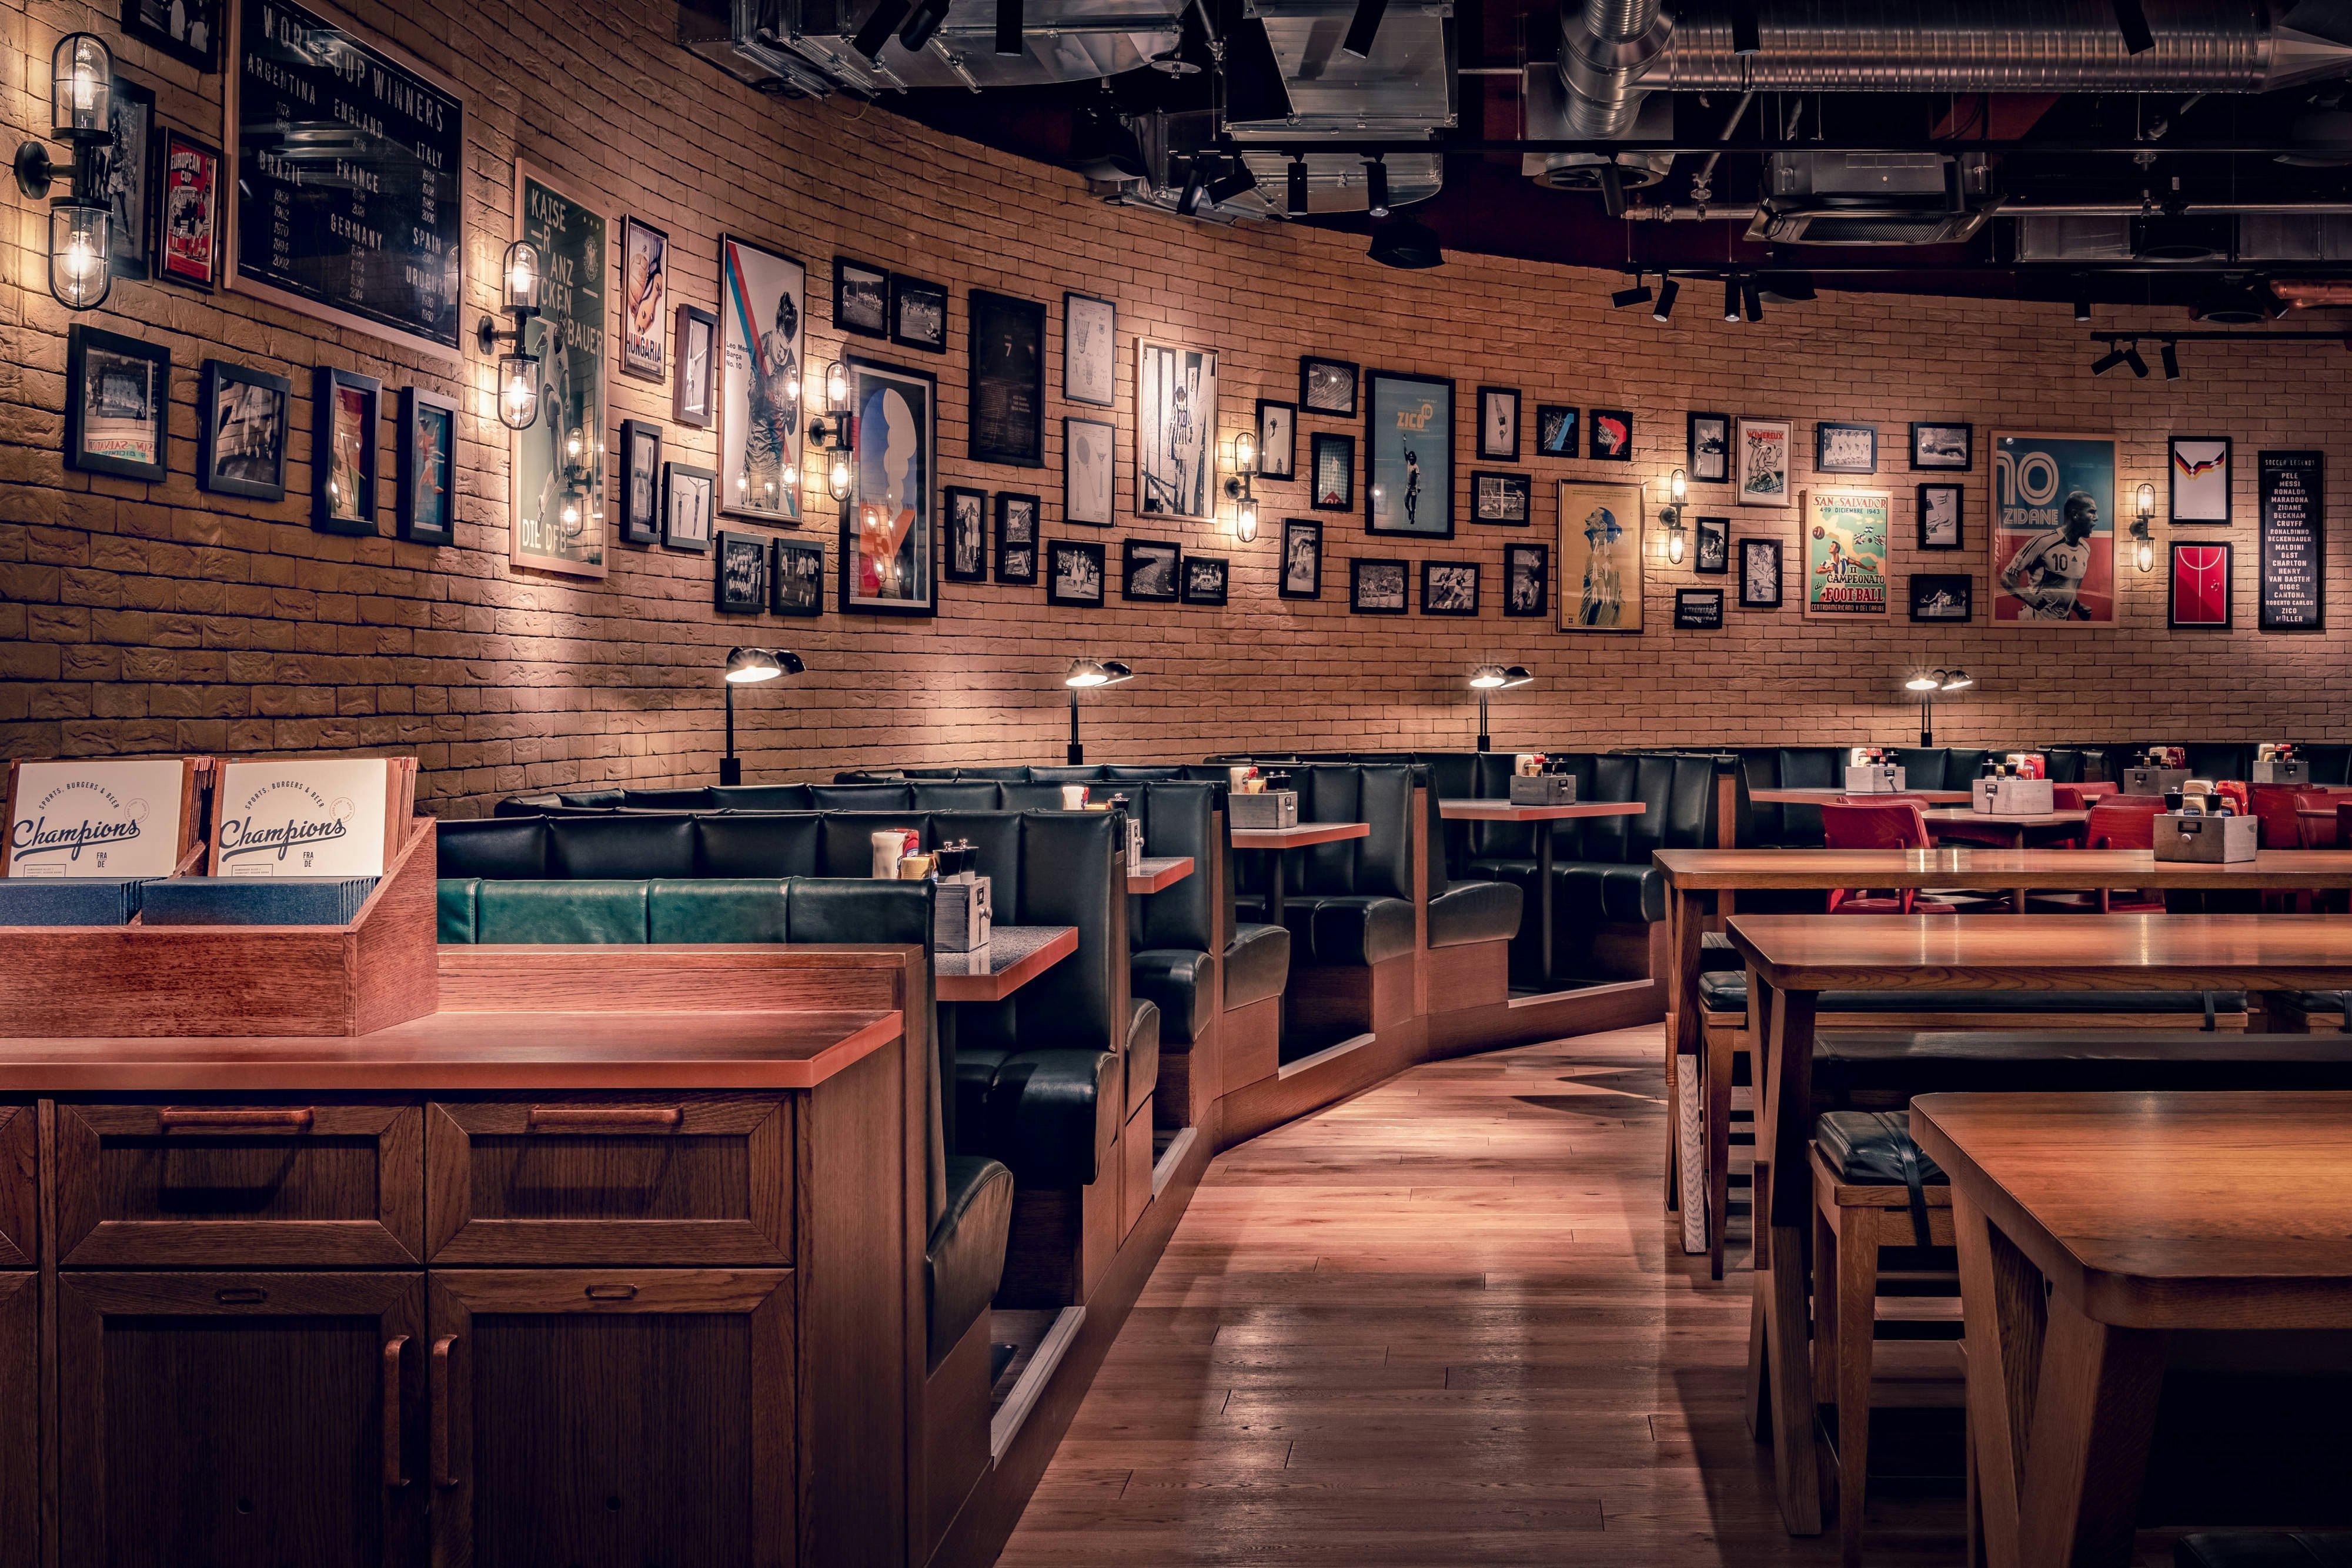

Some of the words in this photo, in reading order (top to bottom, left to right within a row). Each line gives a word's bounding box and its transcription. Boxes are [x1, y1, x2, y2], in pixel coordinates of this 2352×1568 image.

[248, 53, 315, 105] ARGENTINA
[334, 47, 365, 87] CUP
[373, 68, 443, 132] WINNERS
[335, 98, 382, 139] ENGLAND
[171, 152, 201, 174] EUROPEAN
[417, 141, 442, 169] ITALY
[181, 170, 192, 184] CUP
[259, 150, 302, 186] BRAZIL
[337, 157, 379, 193] FRANCE
[274, 189, 289, 205] 1958
[422, 183, 435, 197] 1938
[274, 205, 289, 221] 1962
[422, 209, 435, 225] 2006
[532, 188, 566, 232] KAISE
[274, 222, 289, 237] 1970
[331, 213, 382, 251] GERMANY
[273, 238, 289, 253] 1994
[413, 227, 441, 254] SPAIN
[273, 253, 289, 270] 2002
[422, 295, 434, 308] 1930
[422, 309, 433, 322] 1950
[567, 318, 603, 356] BAUER
[726, 341, 736, 349] Leo
[626, 332, 662, 363] HUNGARIA
[726, 350, 742, 362] Barça
[1005, 343, 1012, 356] 7
[726, 360, 734, 368] No.
[1396, 412, 1425, 429] ZICO
[1746, 431, 1783, 440] WIMEREUX
[1996, 450, 2059, 506] 10
[1813, 497, 1833, 506] SAN
[1838, 497, 1886, 509] SALVADOR
[2003, 507, 2059, 525] ZIDANE
[546, 523, 567, 553] DFB
[2052, 553, 2069, 571] 10
[1814, 581, 1823, 590] de
[1826, 574, 1885, 584] CAMPEONATO
[39, 787, 65, 810] SPORTS,
[66, 781, 99, 791] BURGERS
[106, 792, 120, 810] BEER
[245, 787, 270, 810] SPORTS,
[272, 781, 304, 790] BURGERS
[311, 791, 325, 808] BEER
[12, 816, 141, 862] Champions
[219, 816, 346, 862] Champions
